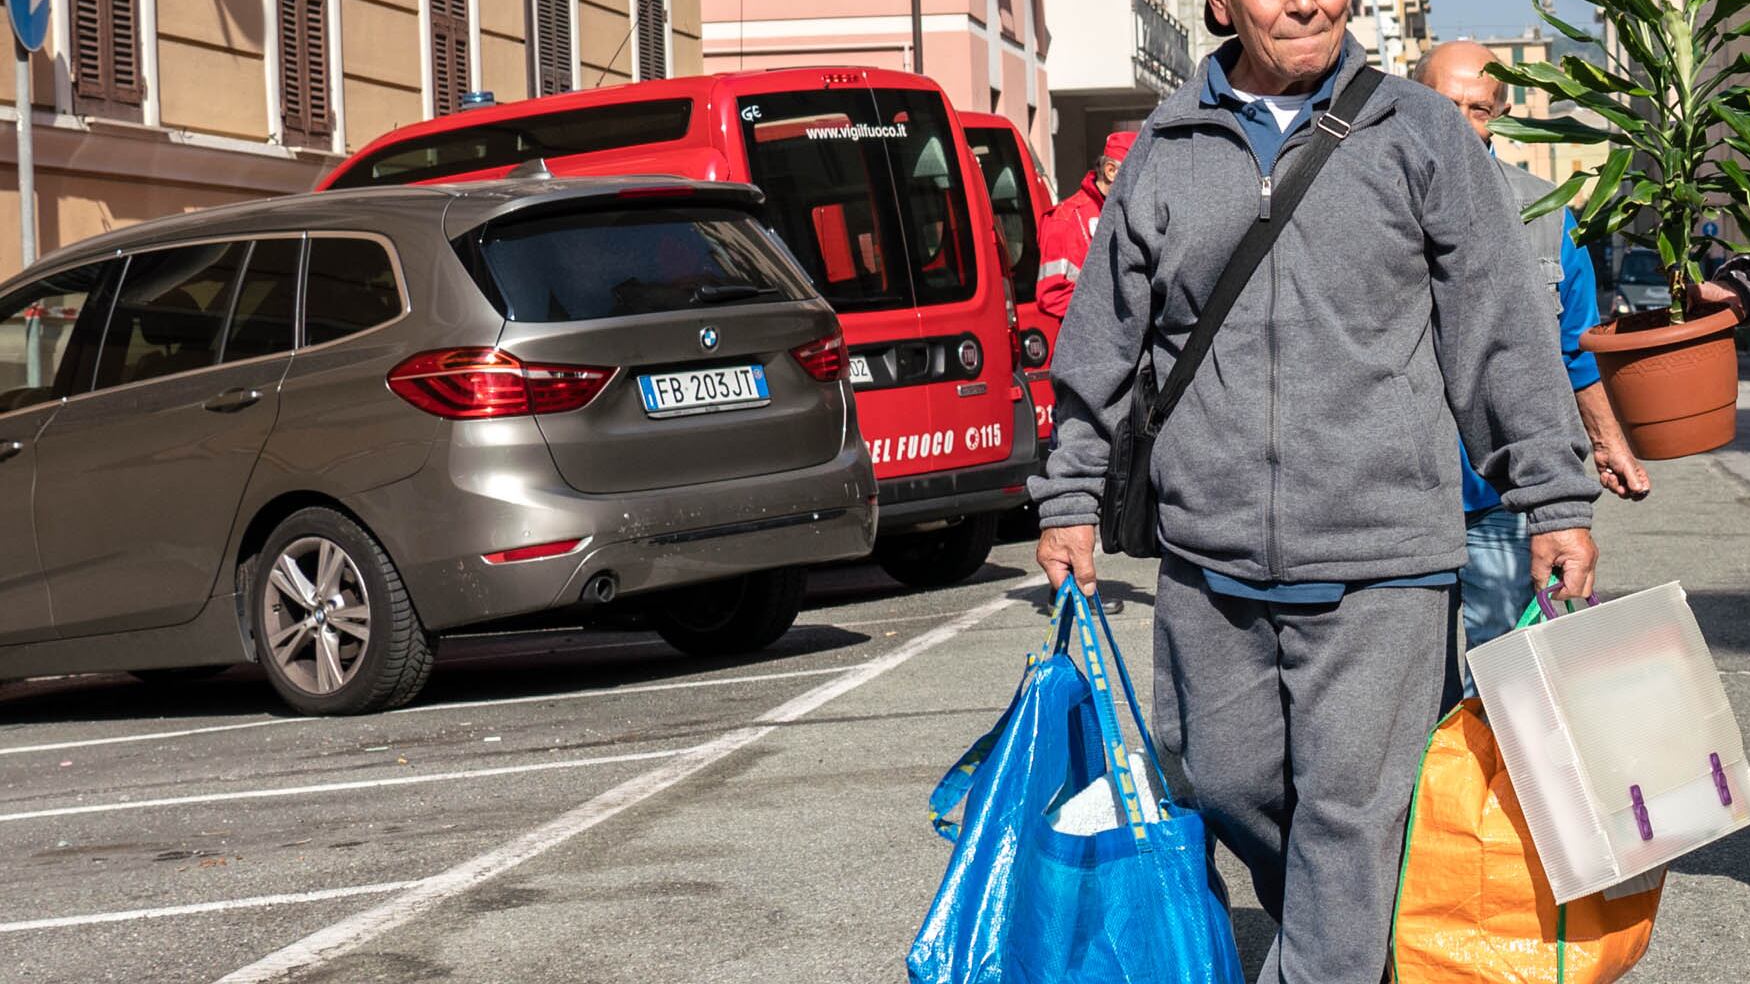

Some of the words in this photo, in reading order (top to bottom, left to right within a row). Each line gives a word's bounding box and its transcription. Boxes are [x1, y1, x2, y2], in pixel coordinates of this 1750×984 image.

[806, 123, 908, 141] www.vigilfuoco.it
[655, 376, 684, 405] FB
[691, 370, 753, 401] 203JT
[896, 429, 955, 461] FUOCO
[980, 423, 1001, 448] 115
